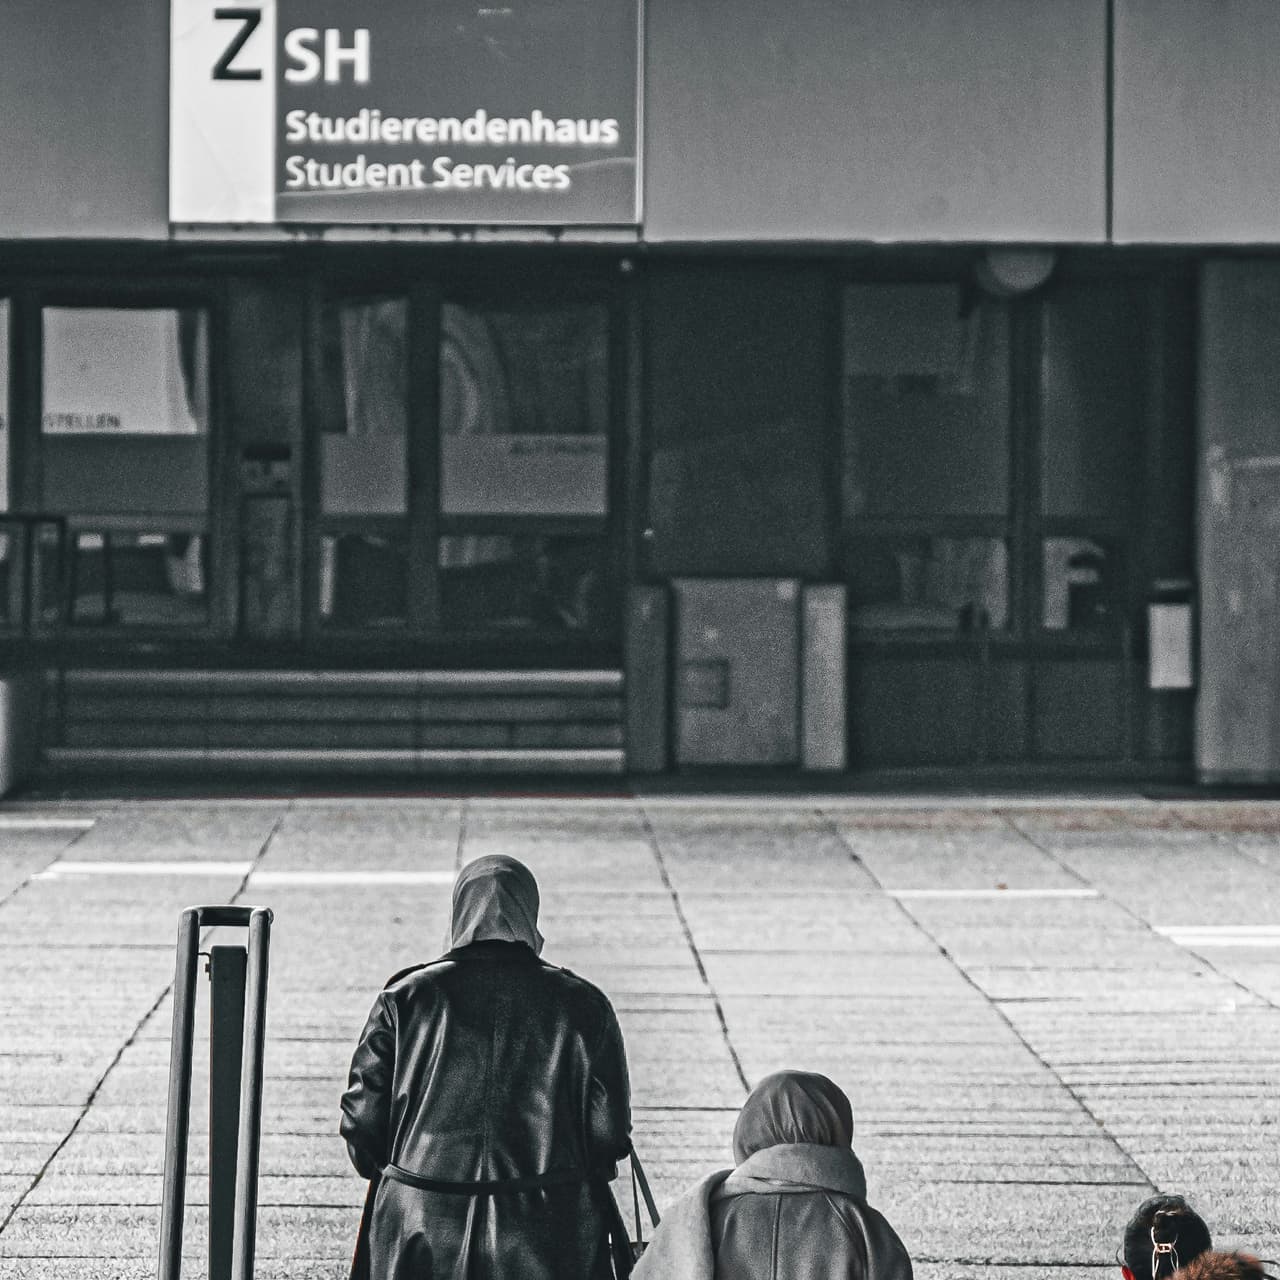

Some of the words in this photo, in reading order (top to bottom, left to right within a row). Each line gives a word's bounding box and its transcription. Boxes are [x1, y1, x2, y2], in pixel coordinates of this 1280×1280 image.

[211, 8, 263, 81] Z
[284, 28, 371, 83] SH
[285, 109, 619, 145] Studierendenhaus
[285, 155, 423, 189] Student
[433, 157, 571, 191] Services
